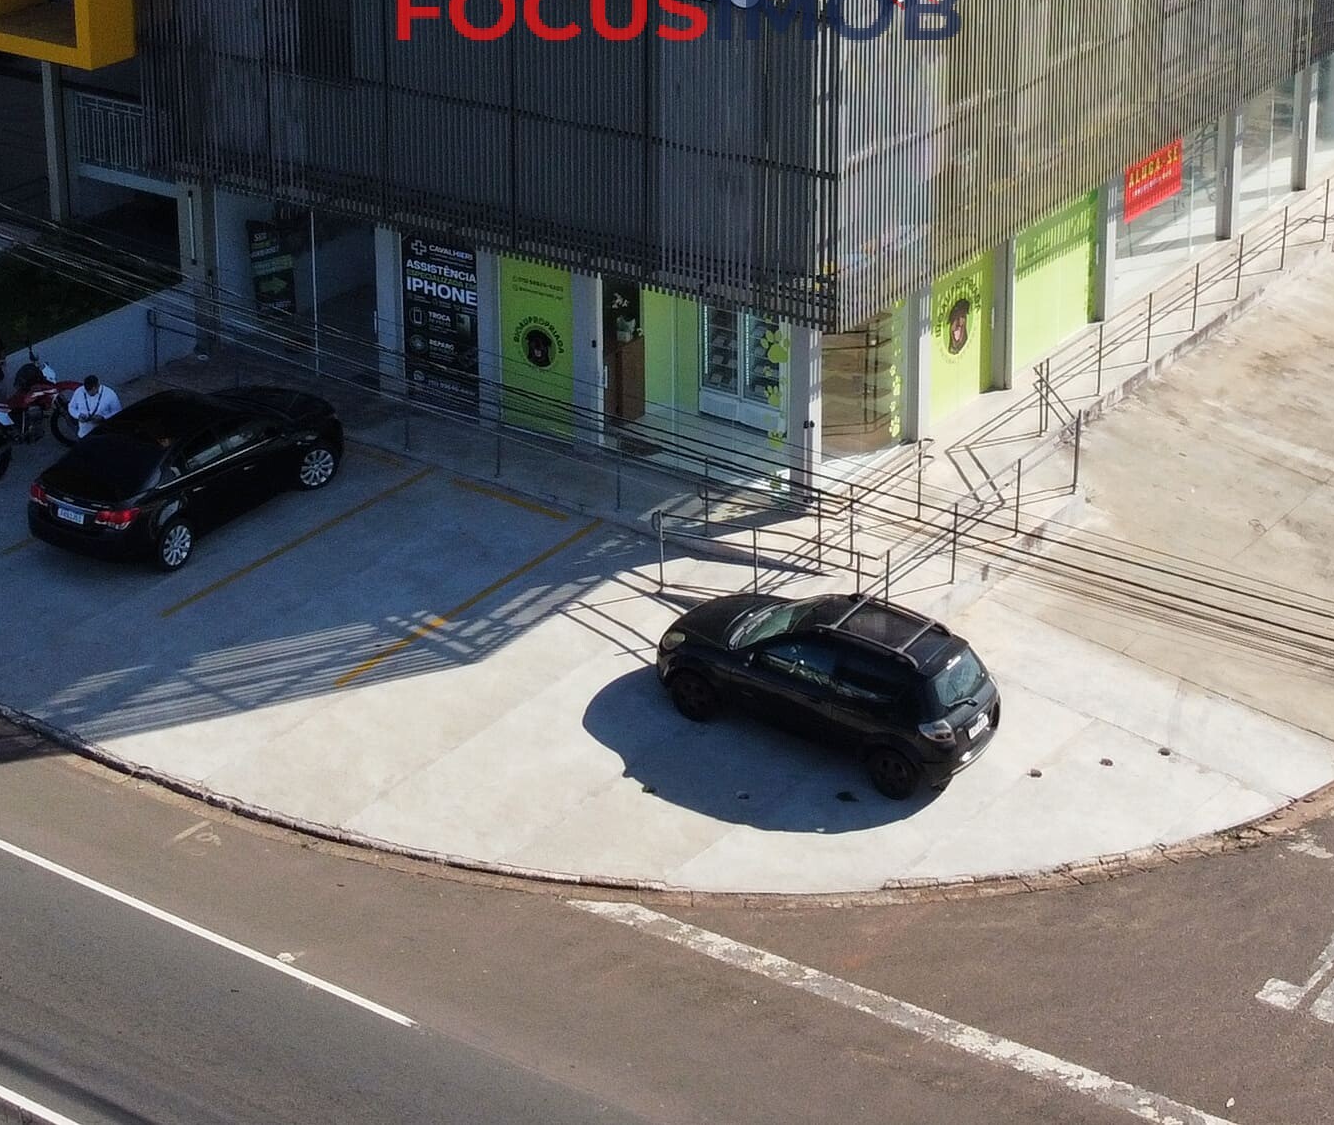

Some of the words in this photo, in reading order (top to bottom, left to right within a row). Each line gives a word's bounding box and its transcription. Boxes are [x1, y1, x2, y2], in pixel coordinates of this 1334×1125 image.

[407, 258, 477, 284] ASSISTÊNCIA
[407, 276, 478, 307] IPHONE
[428, 310, 452, 323] TROCA
